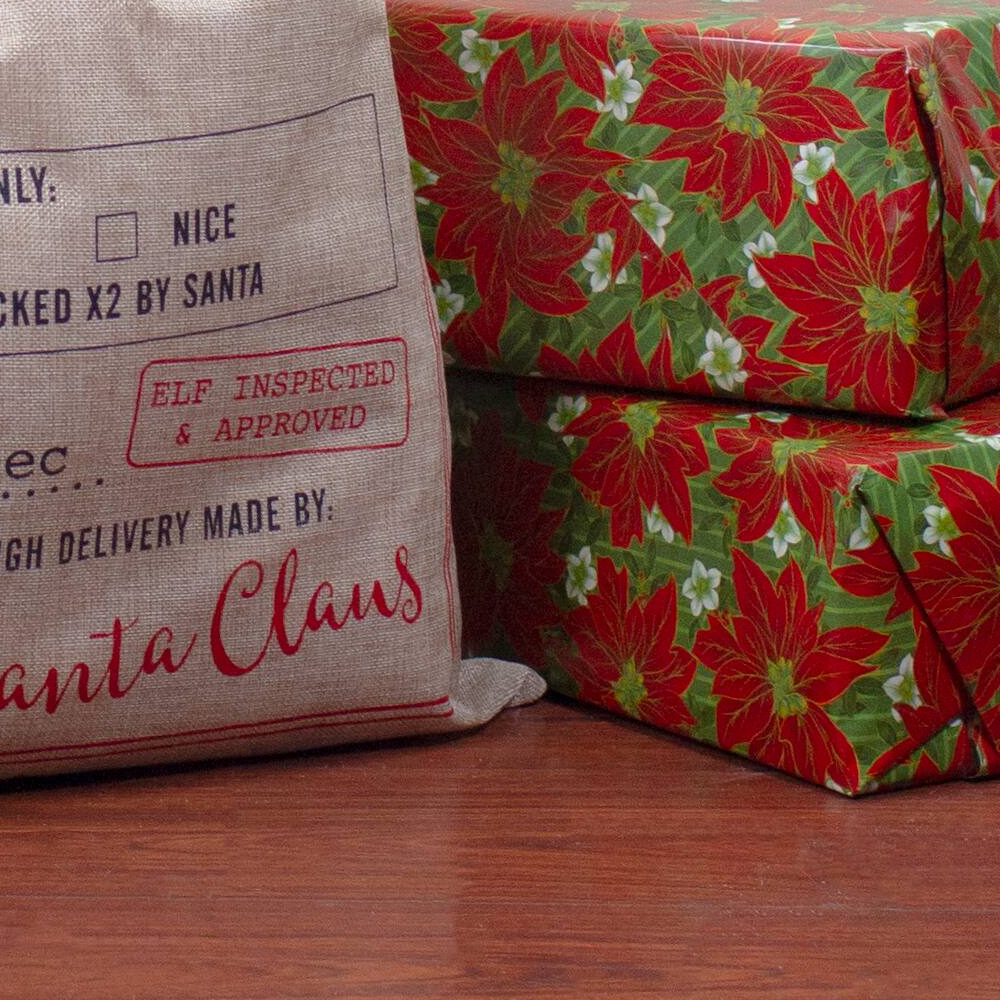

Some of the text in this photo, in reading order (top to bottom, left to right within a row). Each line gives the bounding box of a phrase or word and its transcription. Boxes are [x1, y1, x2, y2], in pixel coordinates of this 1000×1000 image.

[172, 203, 237, 247] NICE
[86, 283, 122, 322] X2
[137, 278, 172, 314] BY
[182, 262, 264, 309] SANTA
[150, 359, 396, 409] ELF INSPECTED
[174, 403, 369, 448] & APPROVED
[58, 510, 192, 565] DELIVERY
[203, 496, 282, 542] MADE
[294, 487, 334, 526] BY:
[210, 545, 424, 677] Claus
